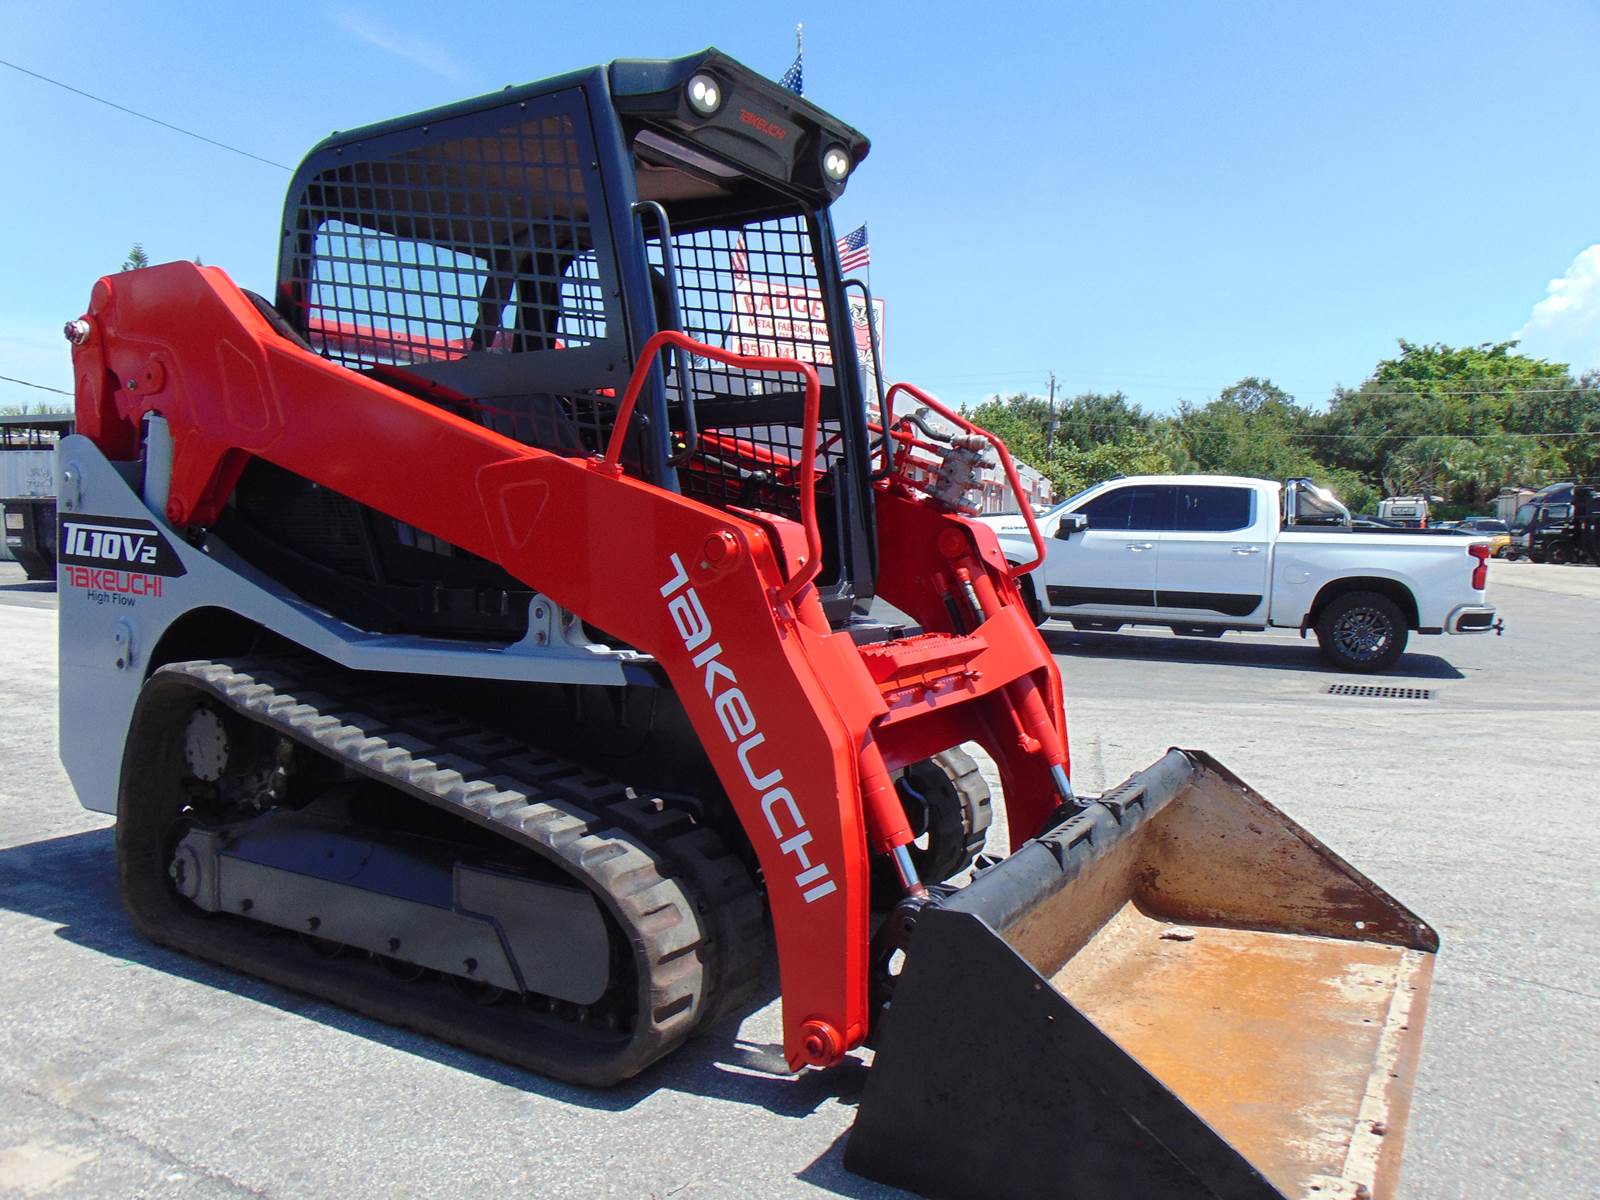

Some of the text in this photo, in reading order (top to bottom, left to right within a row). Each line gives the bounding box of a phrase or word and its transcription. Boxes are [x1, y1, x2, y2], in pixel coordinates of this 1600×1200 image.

[747, 318, 774, 329] META
[87, 590, 136, 607] High Flow
